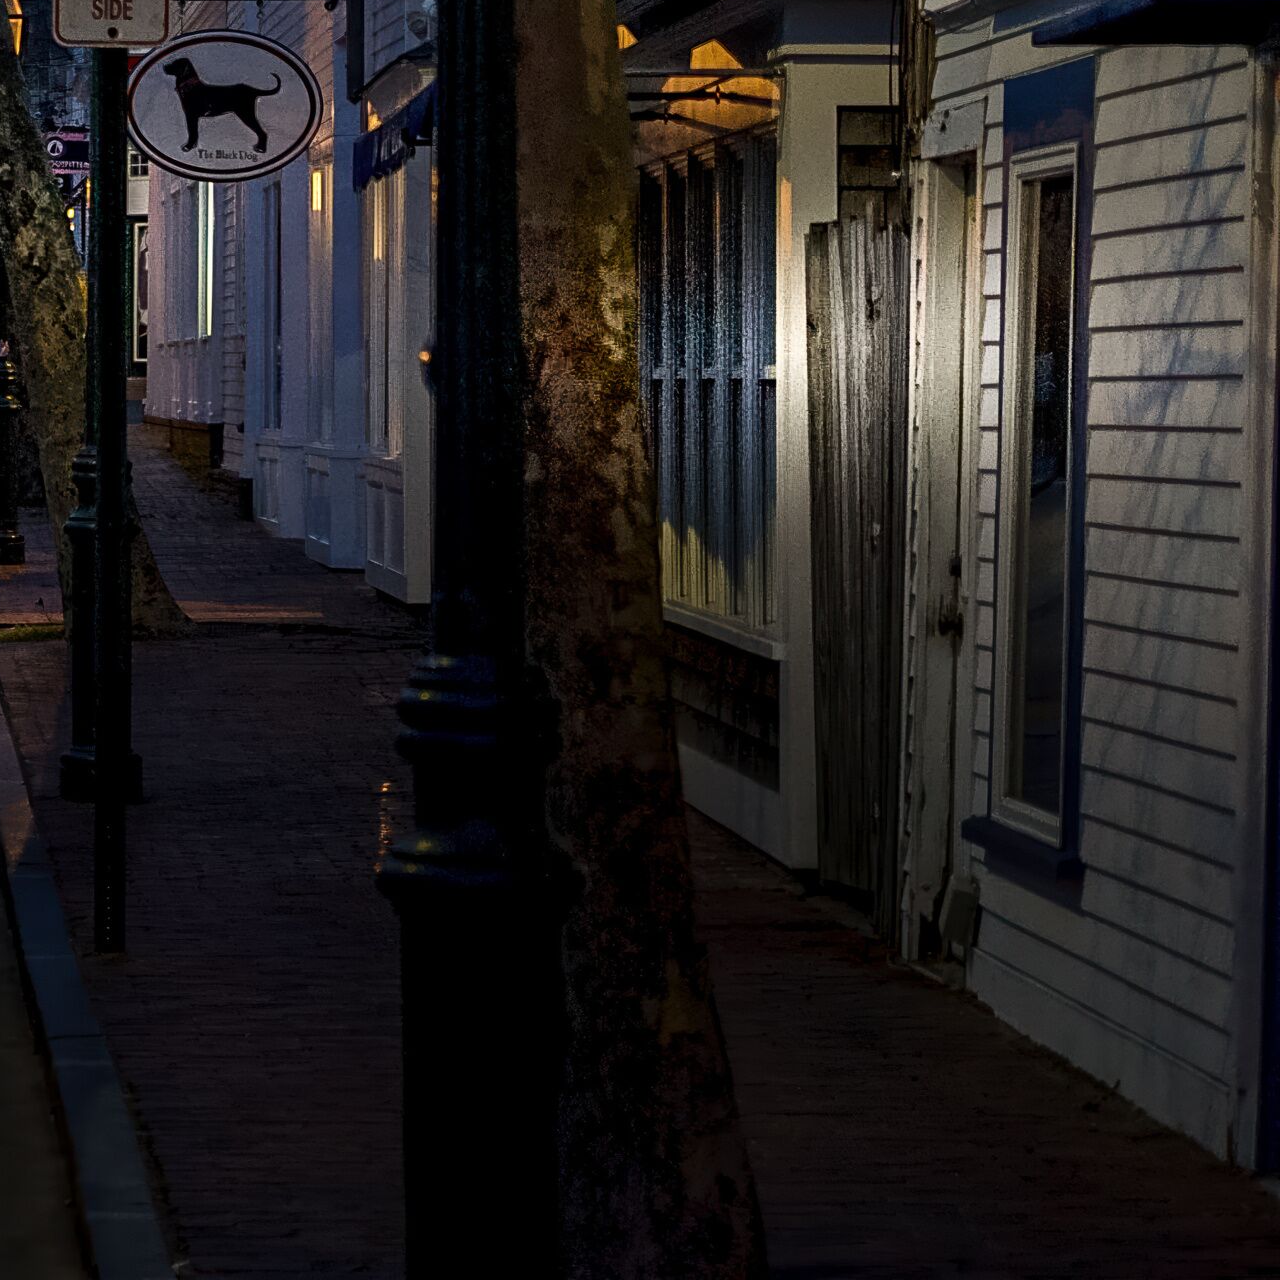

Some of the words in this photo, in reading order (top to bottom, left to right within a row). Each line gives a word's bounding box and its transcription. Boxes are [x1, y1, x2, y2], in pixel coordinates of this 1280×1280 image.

[198, 149, 213, 159] The
[215, 149, 237, 160] Black
[239, 150, 258, 162] Dog
